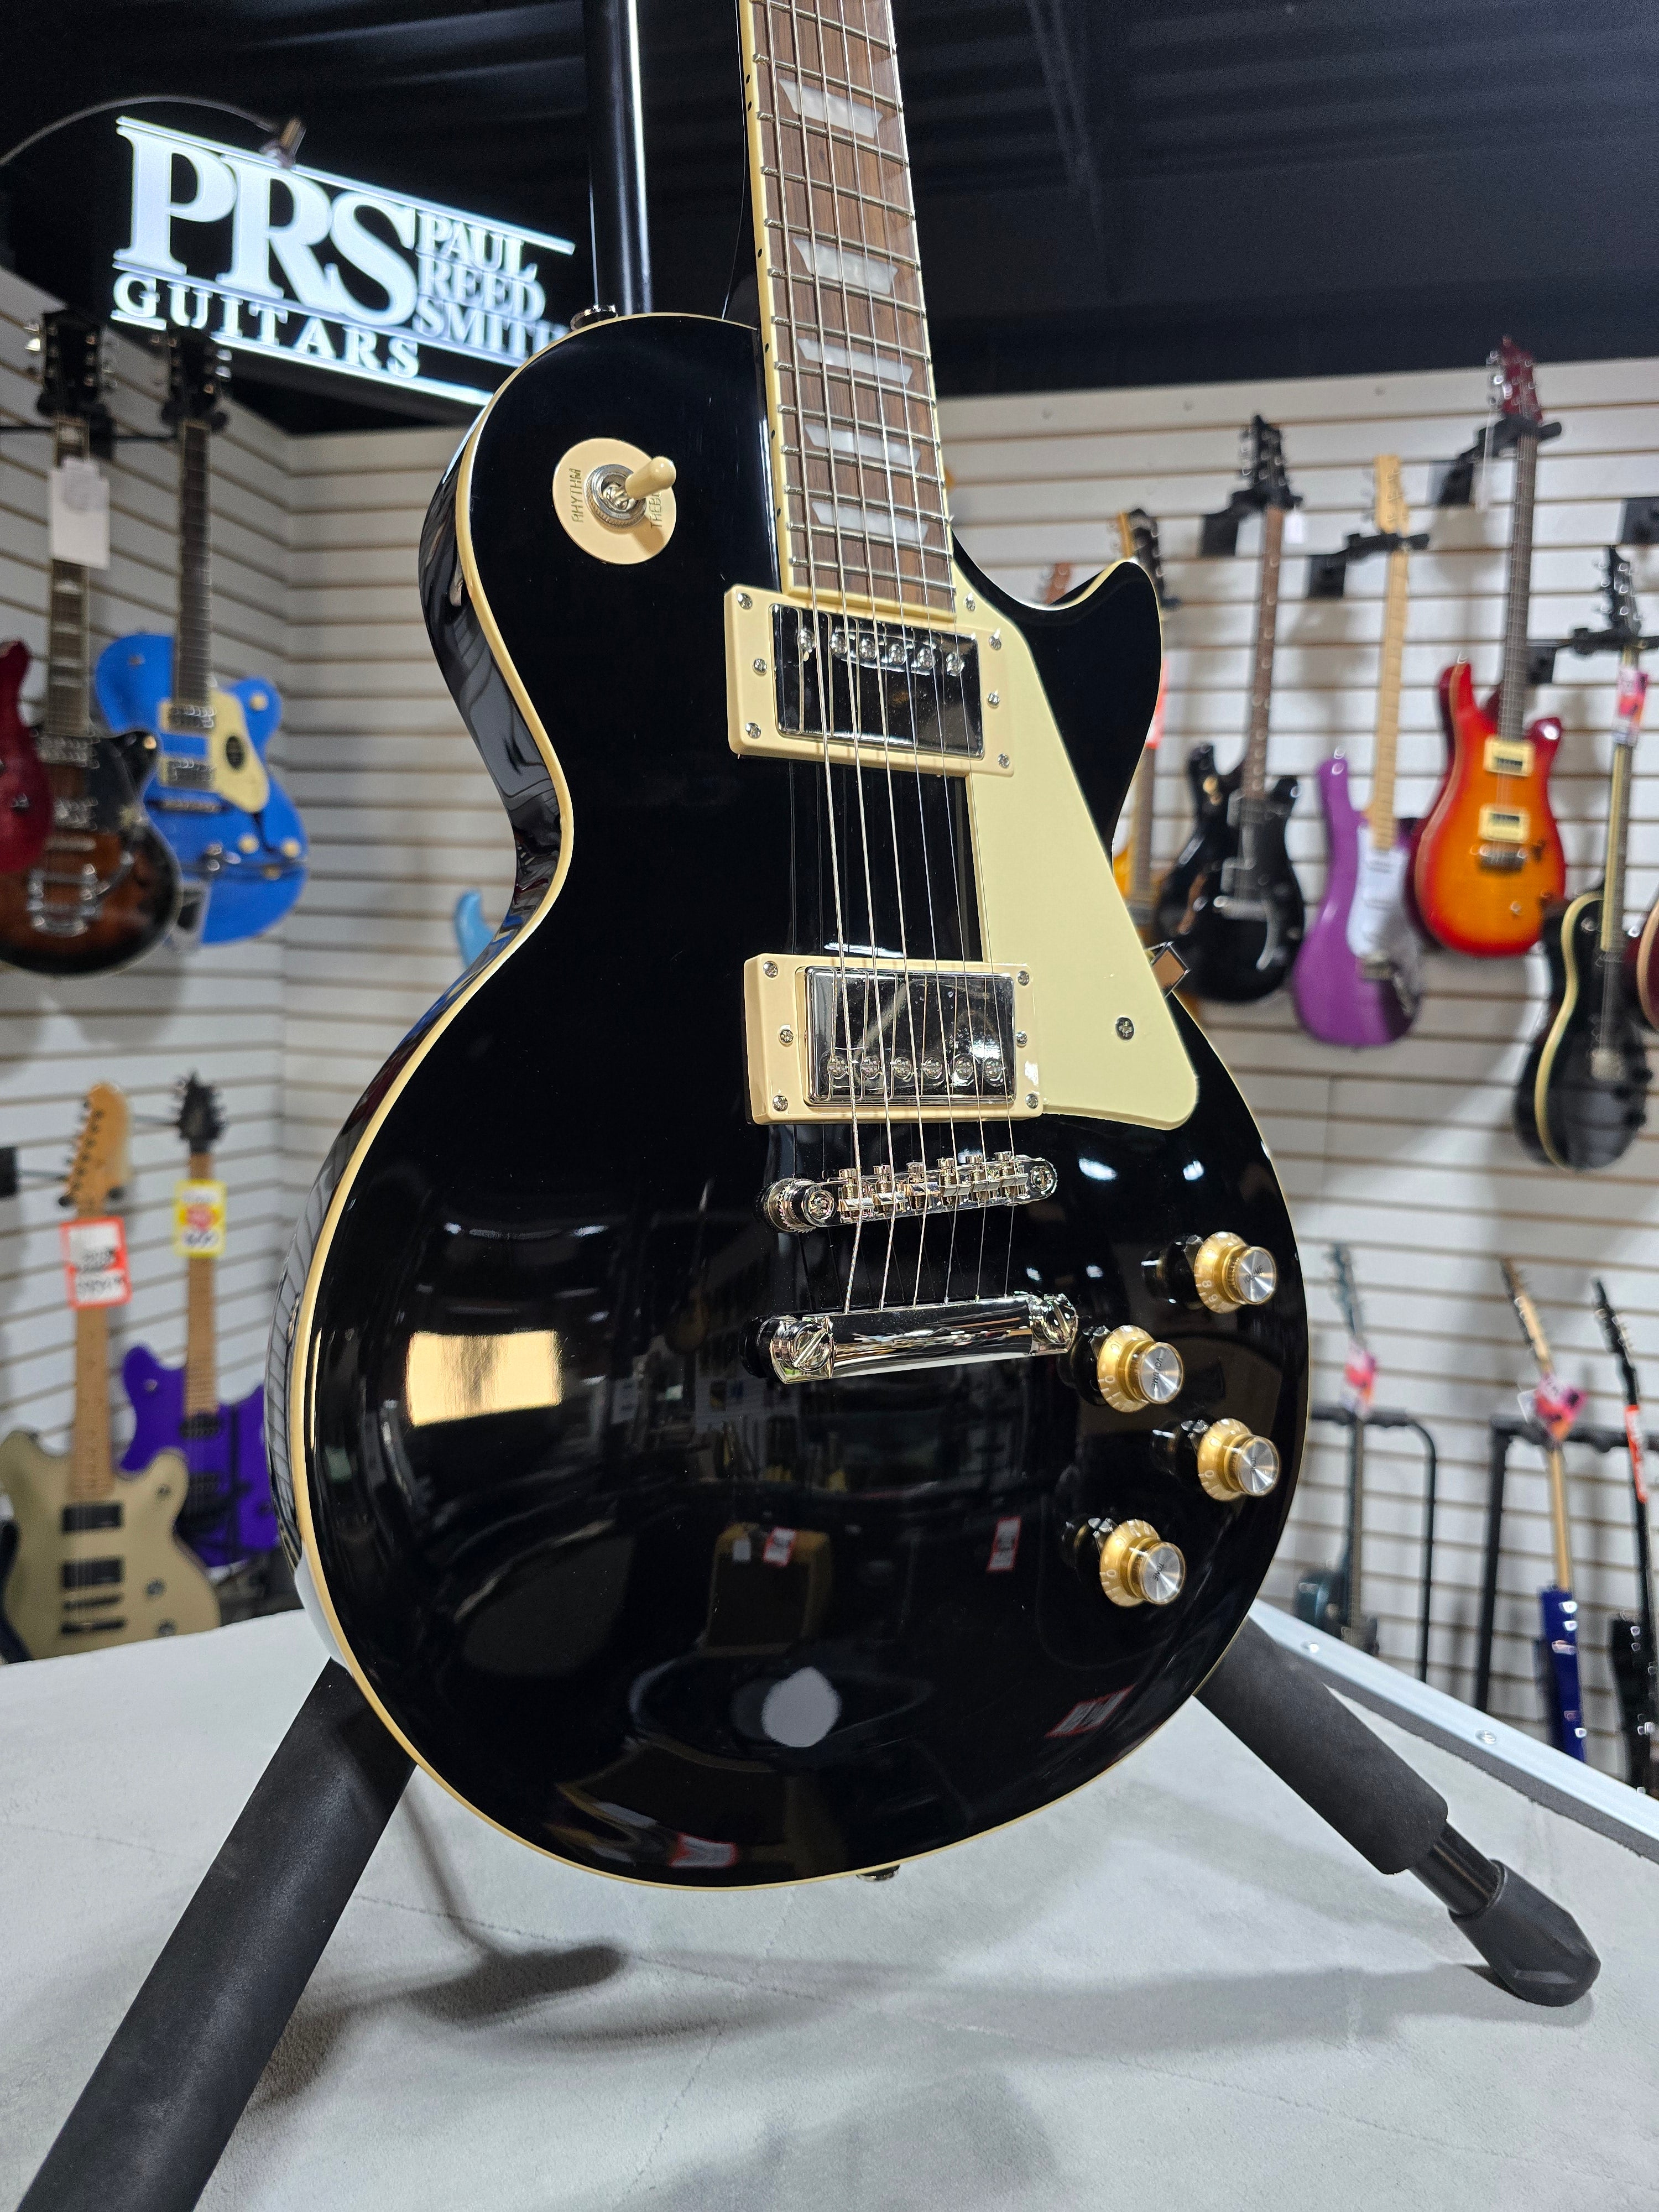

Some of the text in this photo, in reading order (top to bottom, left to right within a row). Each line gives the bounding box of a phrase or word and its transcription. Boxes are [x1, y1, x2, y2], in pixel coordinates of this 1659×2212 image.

[113, 126, 418, 326] PRS
[416, 211, 538, 283] PAUL
[416, 252, 546, 322] REED
[113, 272, 419, 379] GUITARS
[569, 467, 584, 523] RHYTHM
[1202, 1280, 1212, 1288] 8
[1243, 1265, 1264, 1284] VOLUME
[1151, 1357, 1164, 1389] VOLUME
[1152, 1562, 1165, 1582] TONE
